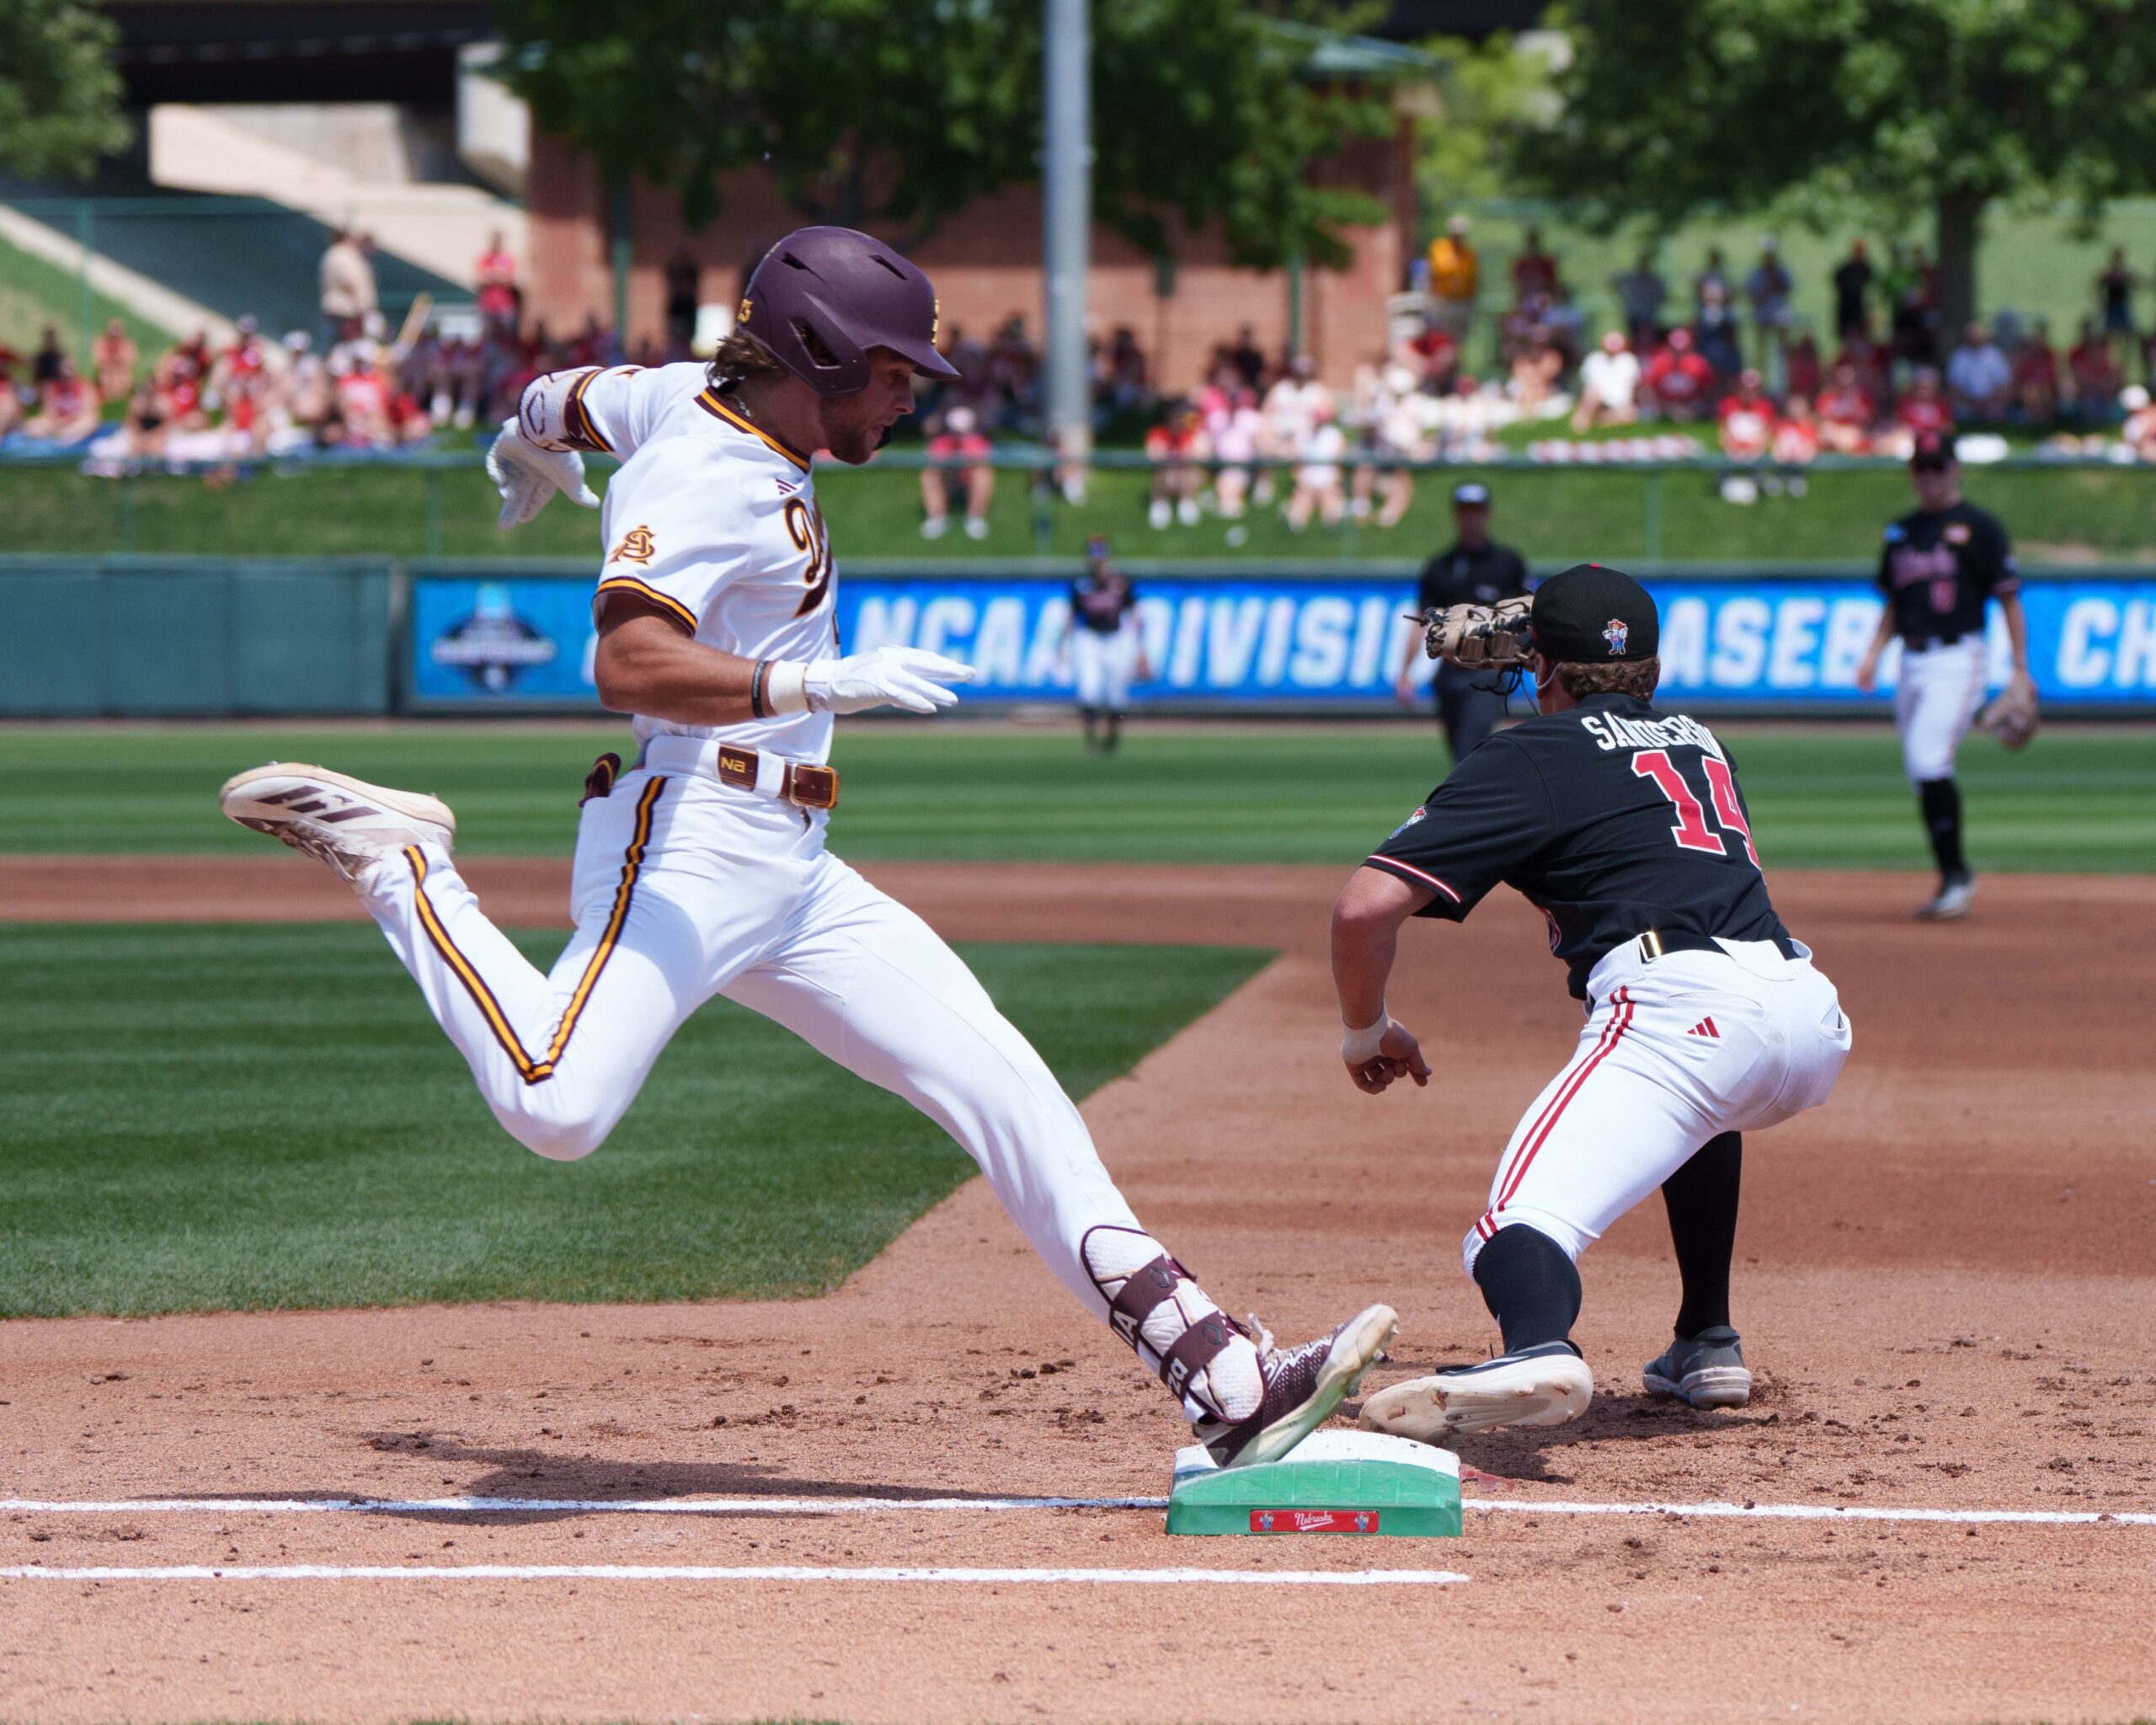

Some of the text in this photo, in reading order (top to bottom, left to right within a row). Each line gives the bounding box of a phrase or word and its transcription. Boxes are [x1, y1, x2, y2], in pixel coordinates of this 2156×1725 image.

[851, 595, 1075, 687] NCAA
[1123, 595, 1447, 688] DIVISIO
[1631, 749, 1763, 873] 14
[1294, 1510, 1334, 1529] Nebraska
